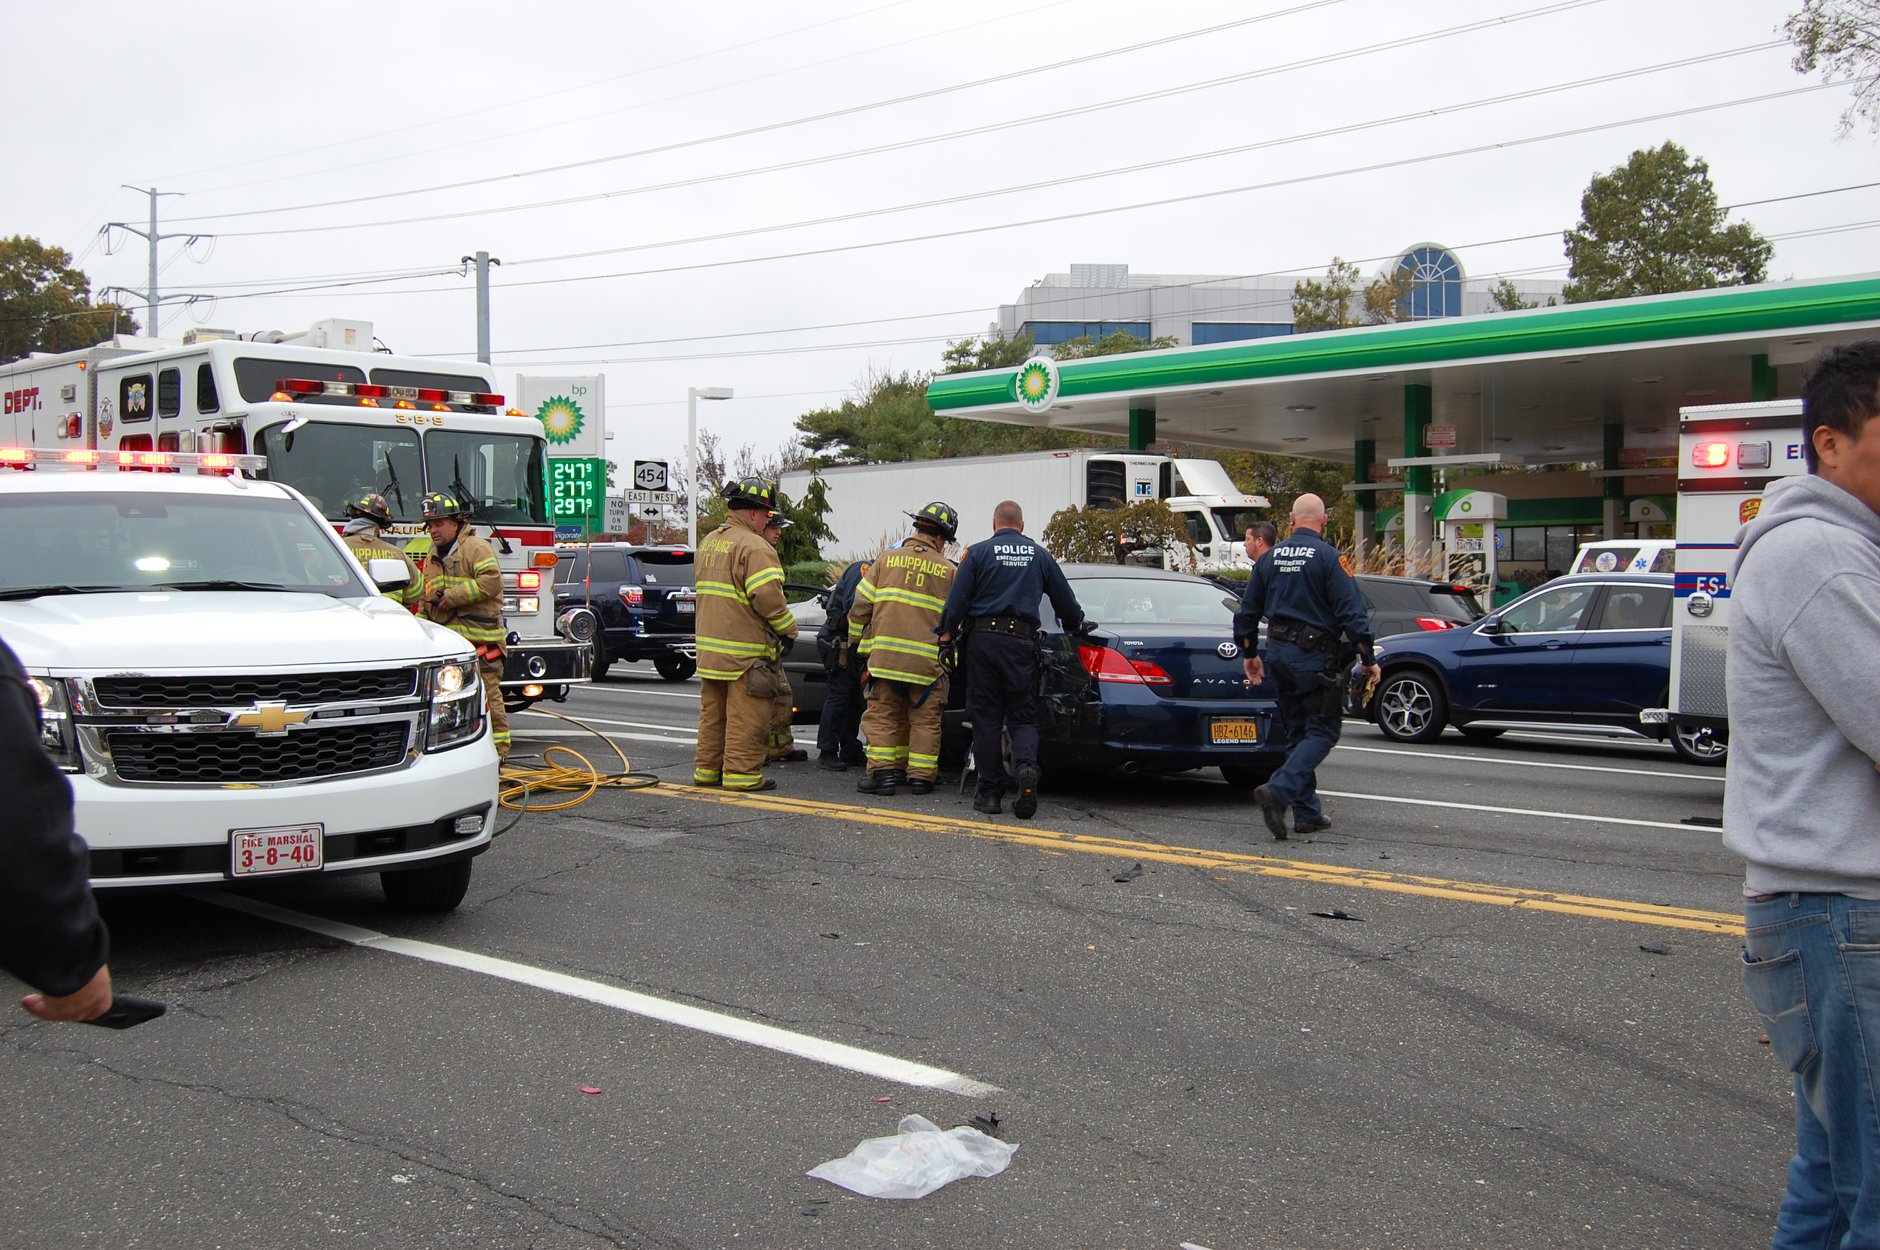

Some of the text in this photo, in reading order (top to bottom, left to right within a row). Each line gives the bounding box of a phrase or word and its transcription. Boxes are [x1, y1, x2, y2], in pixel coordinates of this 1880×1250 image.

[572, 384, 587, 396] bp
[4, 387, 42, 414] DEPT.
[637, 469, 664, 483] 454
[628, 491, 646, 501] EAST
[655, 493, 674, 502] WEST
[993, 545, 1035, 555] POLICE
[1273, 546, 1316, 559] POLICE
[886, 555, 949, 579] HAUPPAUGE
[242, 834, 314, 848] FIRE MARSHAL
[242, 845, 314, 867] 3-8-40
